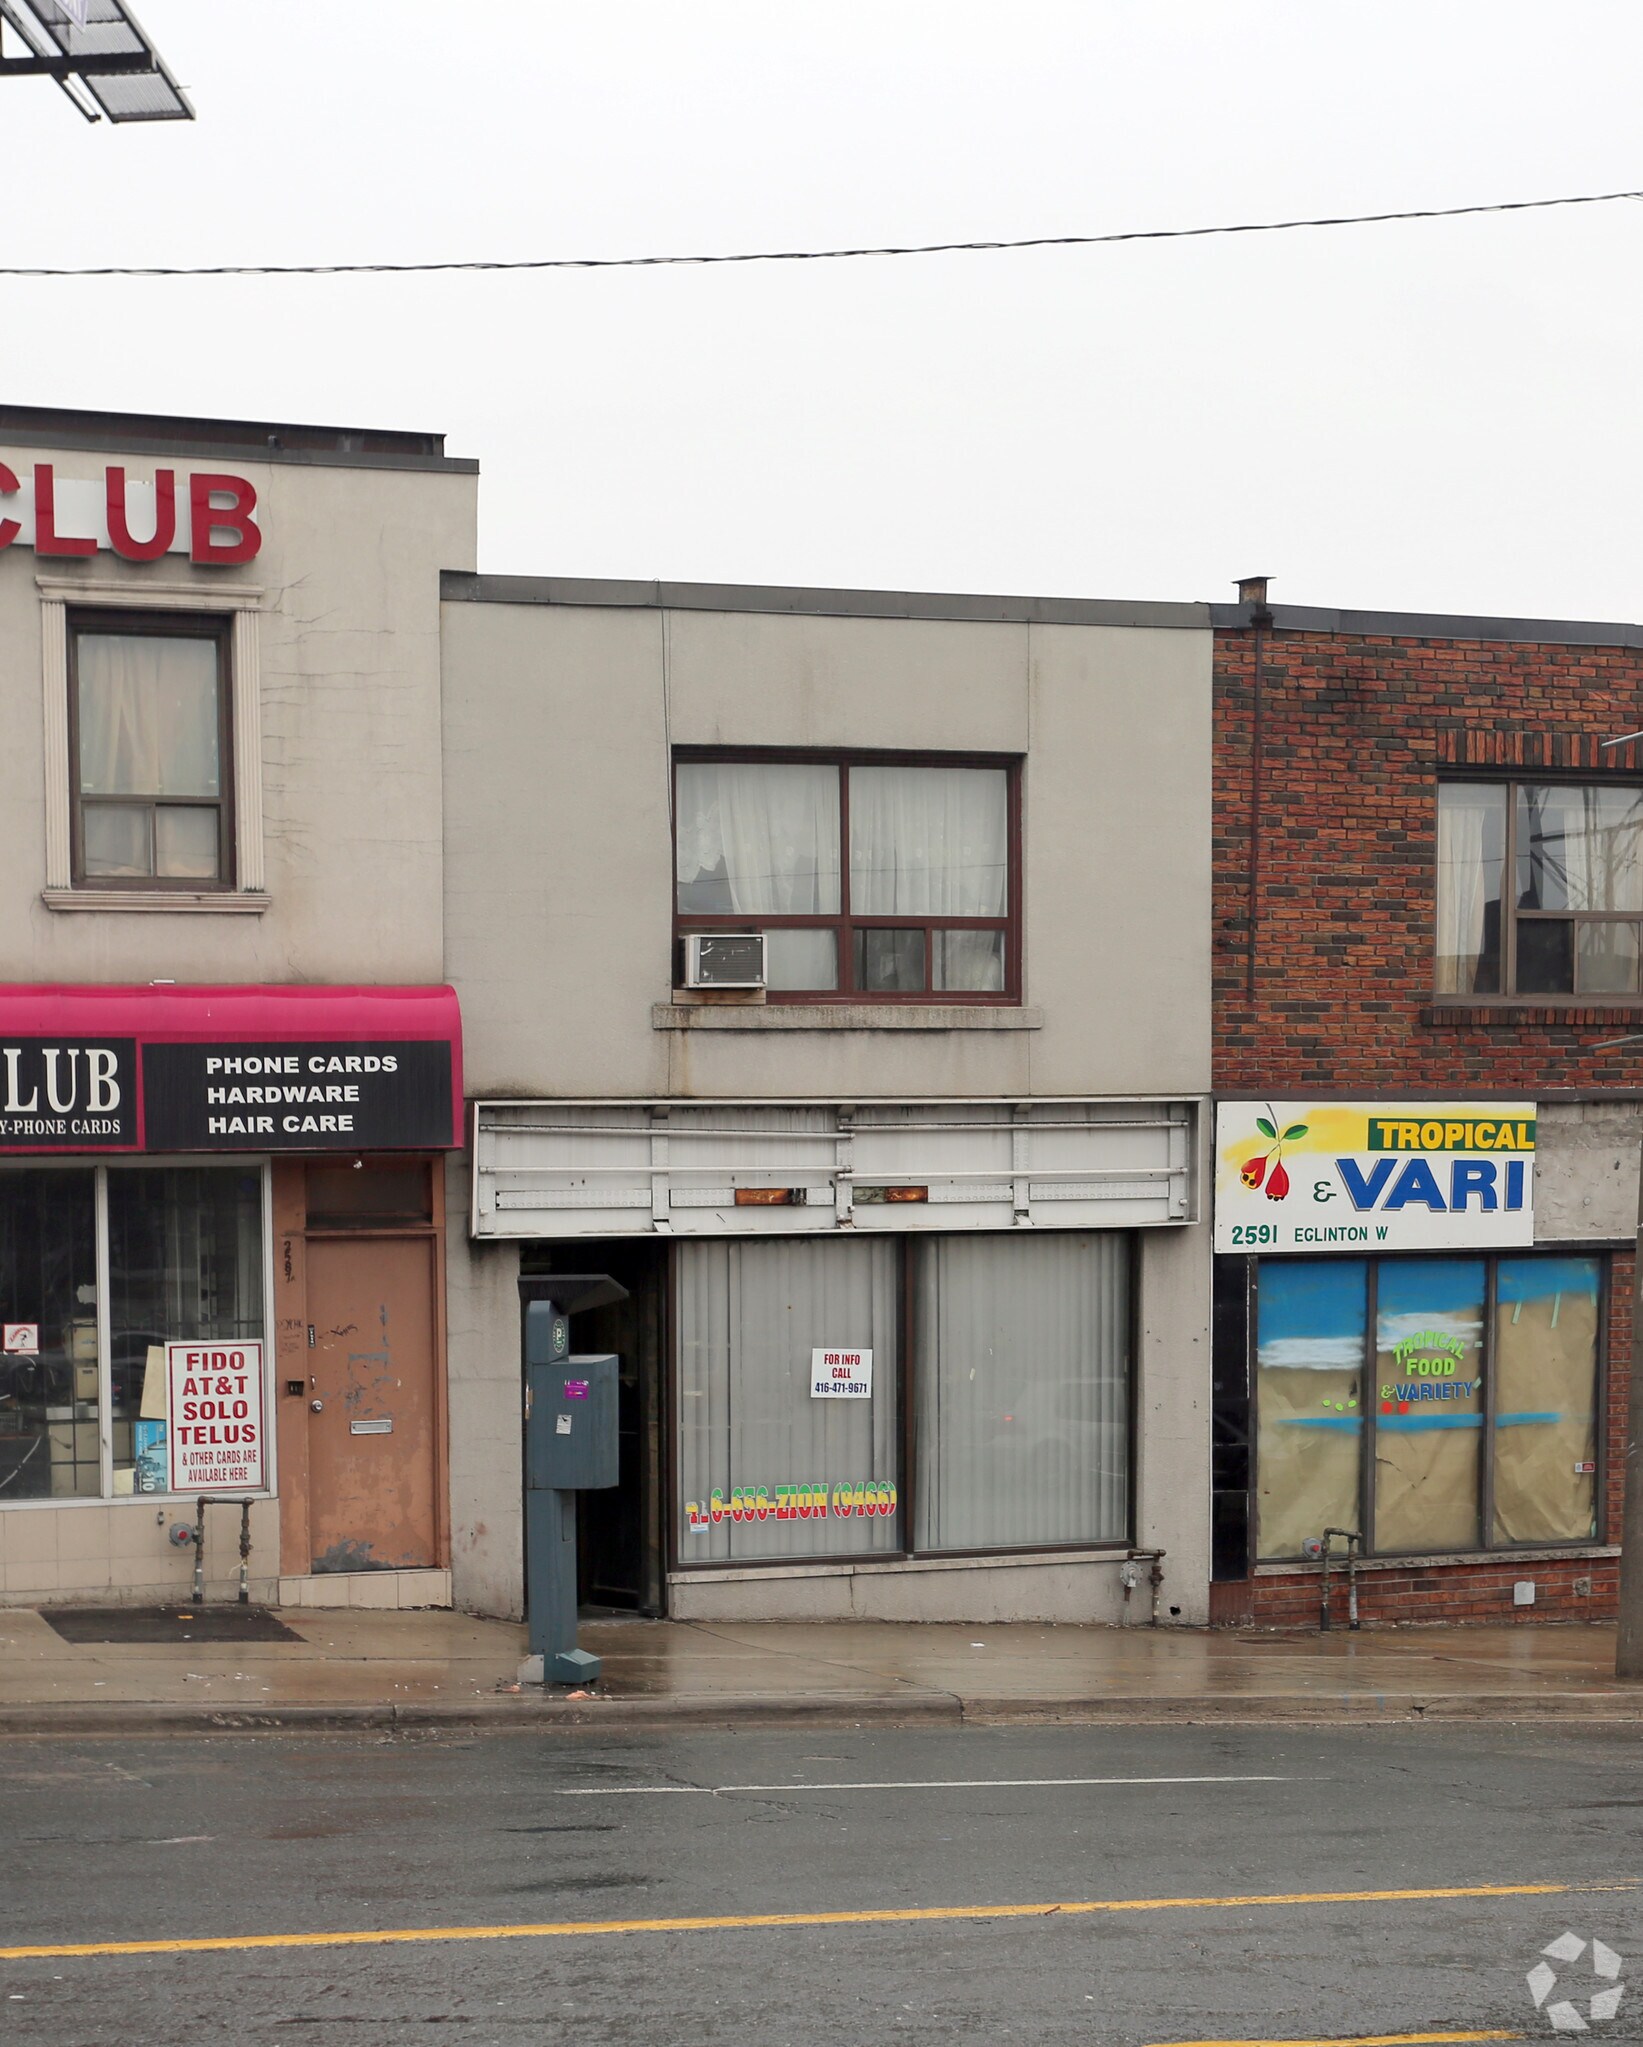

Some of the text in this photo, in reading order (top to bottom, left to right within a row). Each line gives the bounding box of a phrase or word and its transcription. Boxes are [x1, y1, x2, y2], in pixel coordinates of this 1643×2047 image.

[0, 462, 262, 565] LUB
[206, 1056, 398, 1074] PHONE CARDS
[207, 1085, 360, 1104] HARDWARE
[0, 1119, 121, 1135] Y-PHONE CARDS
[208, 1115, 354, 1134] HAIR CARE
[1377, 1121, 1535, 1150] TROPICAL
[1313, 1181, 1337, 1202] &
[1231, 1224, 1389, 1245] 2591 EGLINTON W
[1392, 1330, 1465, 1366] TROPICAL
[186, 1351, 245, 1371] FIDO
[824, 1353, 861, 1366] FOR INFO
[1406, 1357, 1456, 1376] FOOD
[832, 1367, 852, 1379] CALL
[182, 1376, 249, 1396] AT&T
[815, 1382, 868, 1393] 416-471-9671
[183, 1400, 248, 1421] SOLO
[177, 1424, 256, 1445] TELUS
[182, 1449, 257, 1466] & OTHER CARDS ARE
[188, 1467, 248, 1482] AVAILABLE HERE
